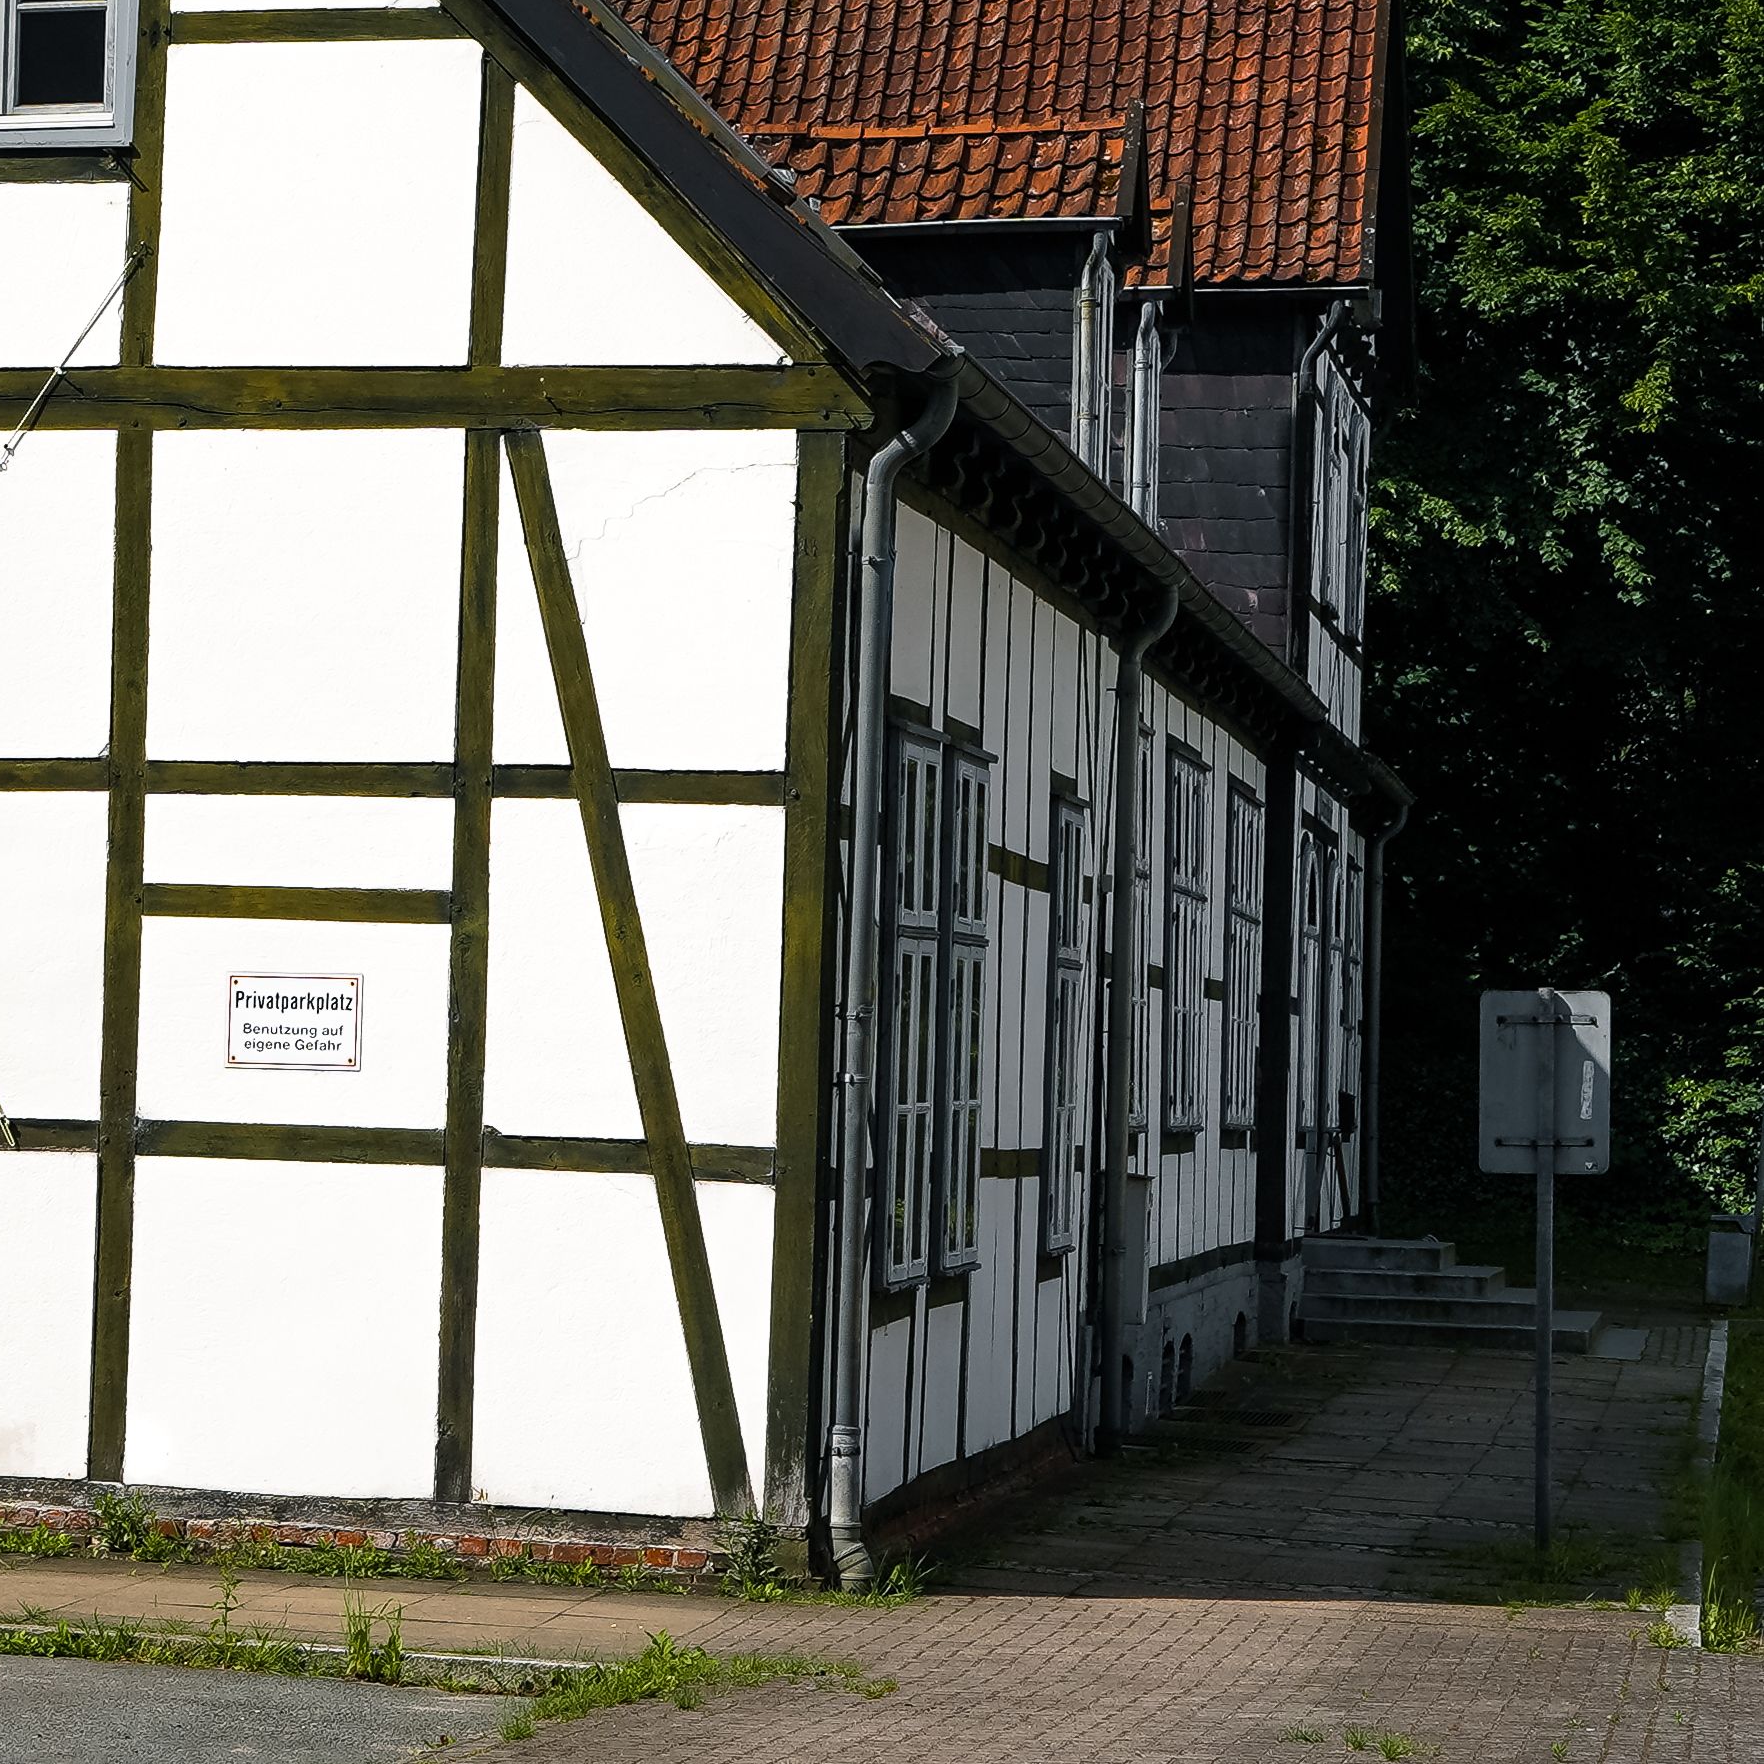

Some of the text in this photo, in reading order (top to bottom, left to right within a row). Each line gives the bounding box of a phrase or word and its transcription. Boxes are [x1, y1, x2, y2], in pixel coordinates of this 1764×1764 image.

[235, 990, 353, 1014] Privatparkplatz
[242, 1022, 344, 1038] Benutzung auf
[244, 1038, 342, 1052] eigene Gefahr
